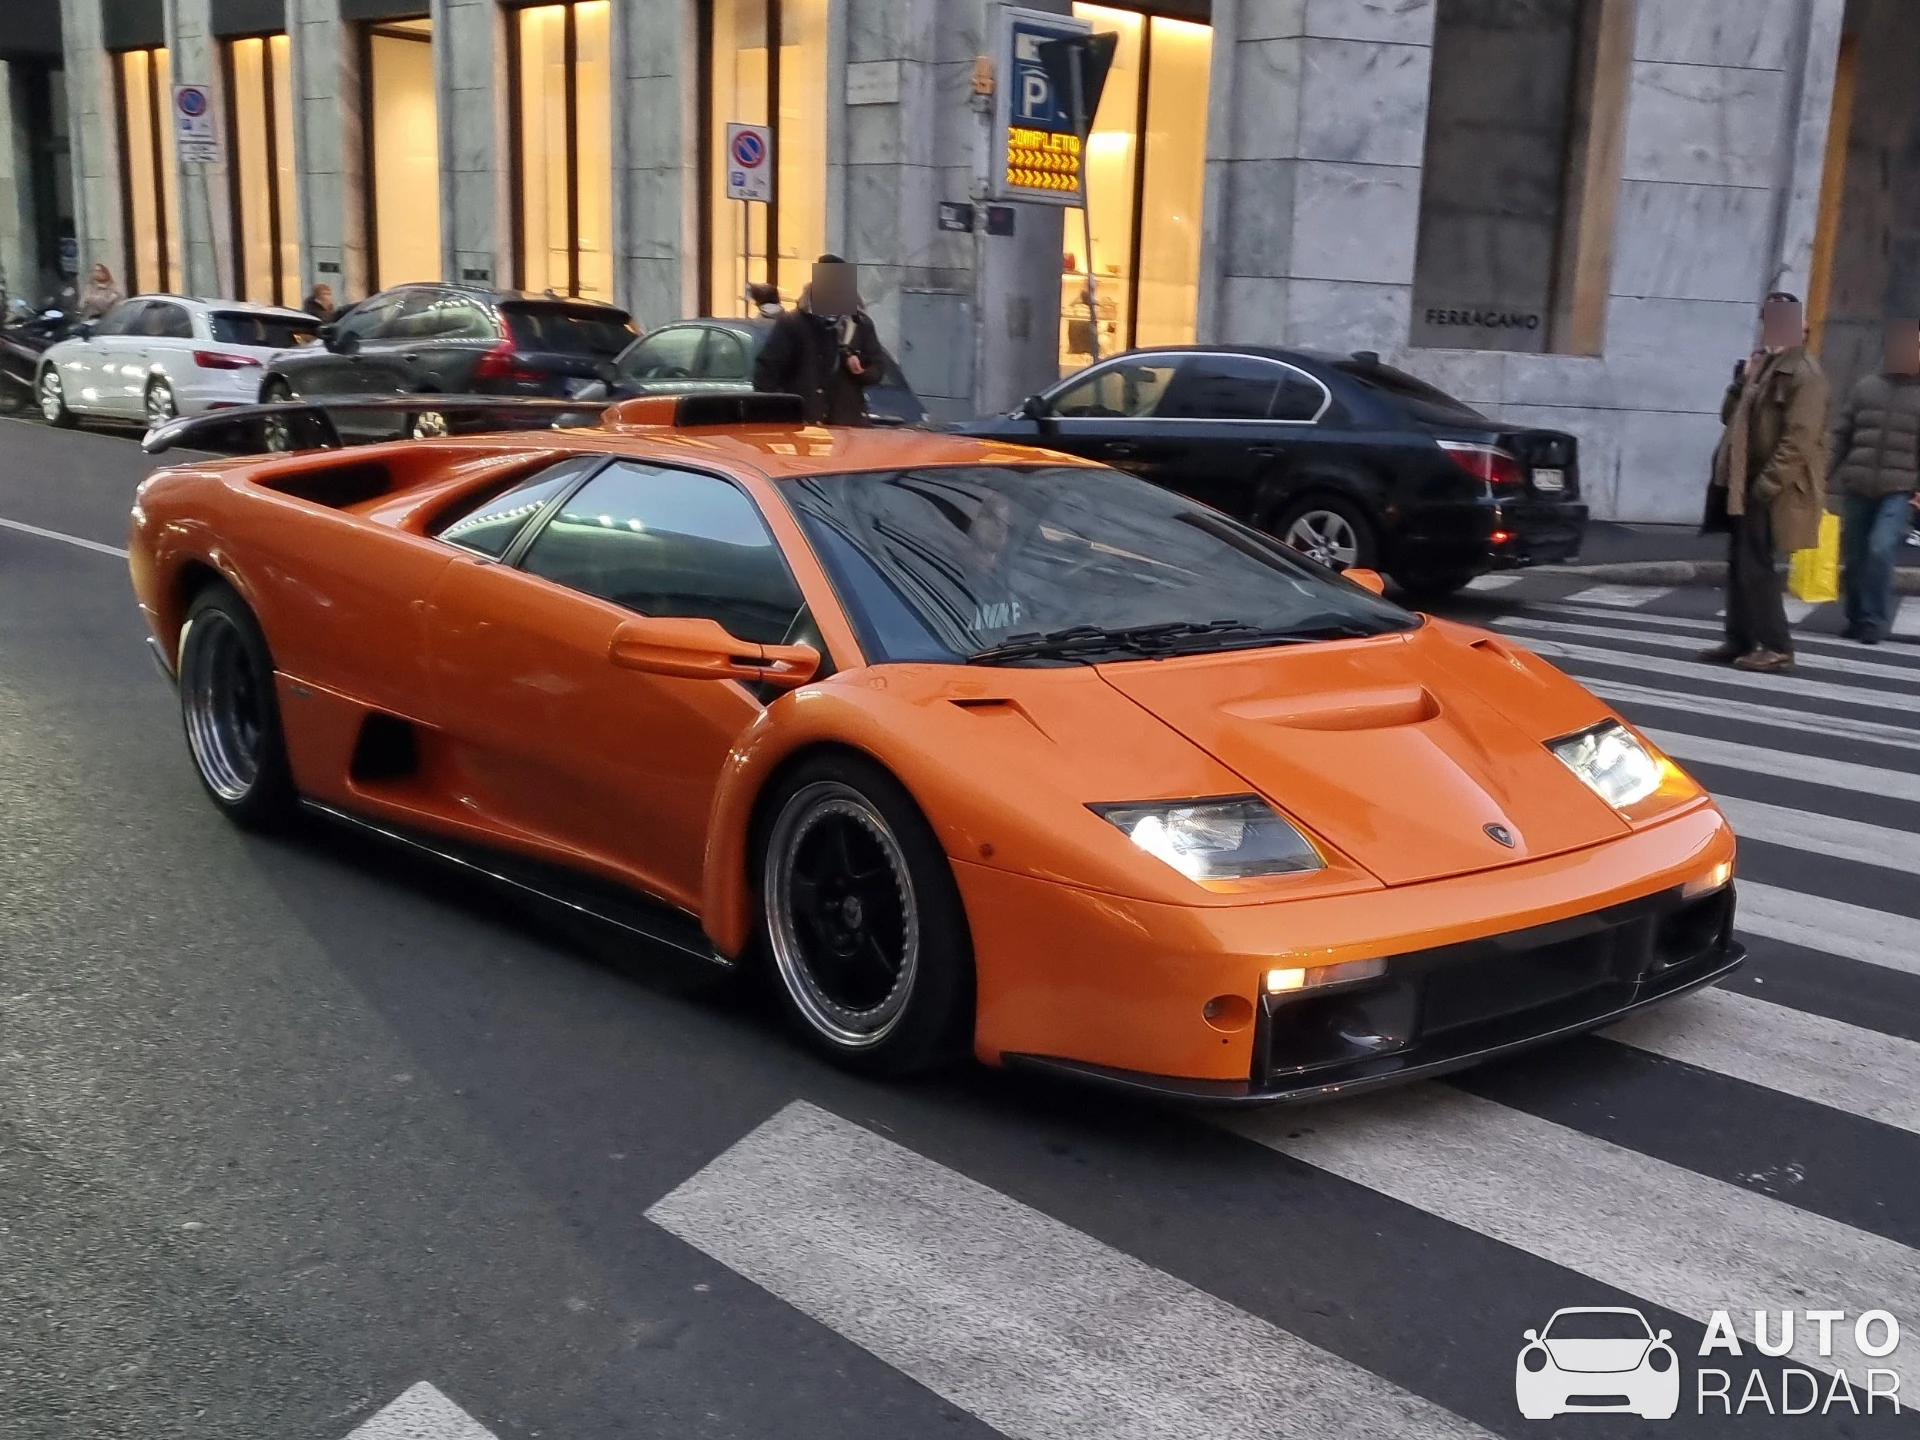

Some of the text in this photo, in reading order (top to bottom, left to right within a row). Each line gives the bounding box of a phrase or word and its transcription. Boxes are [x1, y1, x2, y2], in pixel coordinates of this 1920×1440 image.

[1022, 75, 1048, 117] P
[1008, 127, 1080, 152] COMPLETO
[1425, 308, 1539, 329] FERRAGAMO
